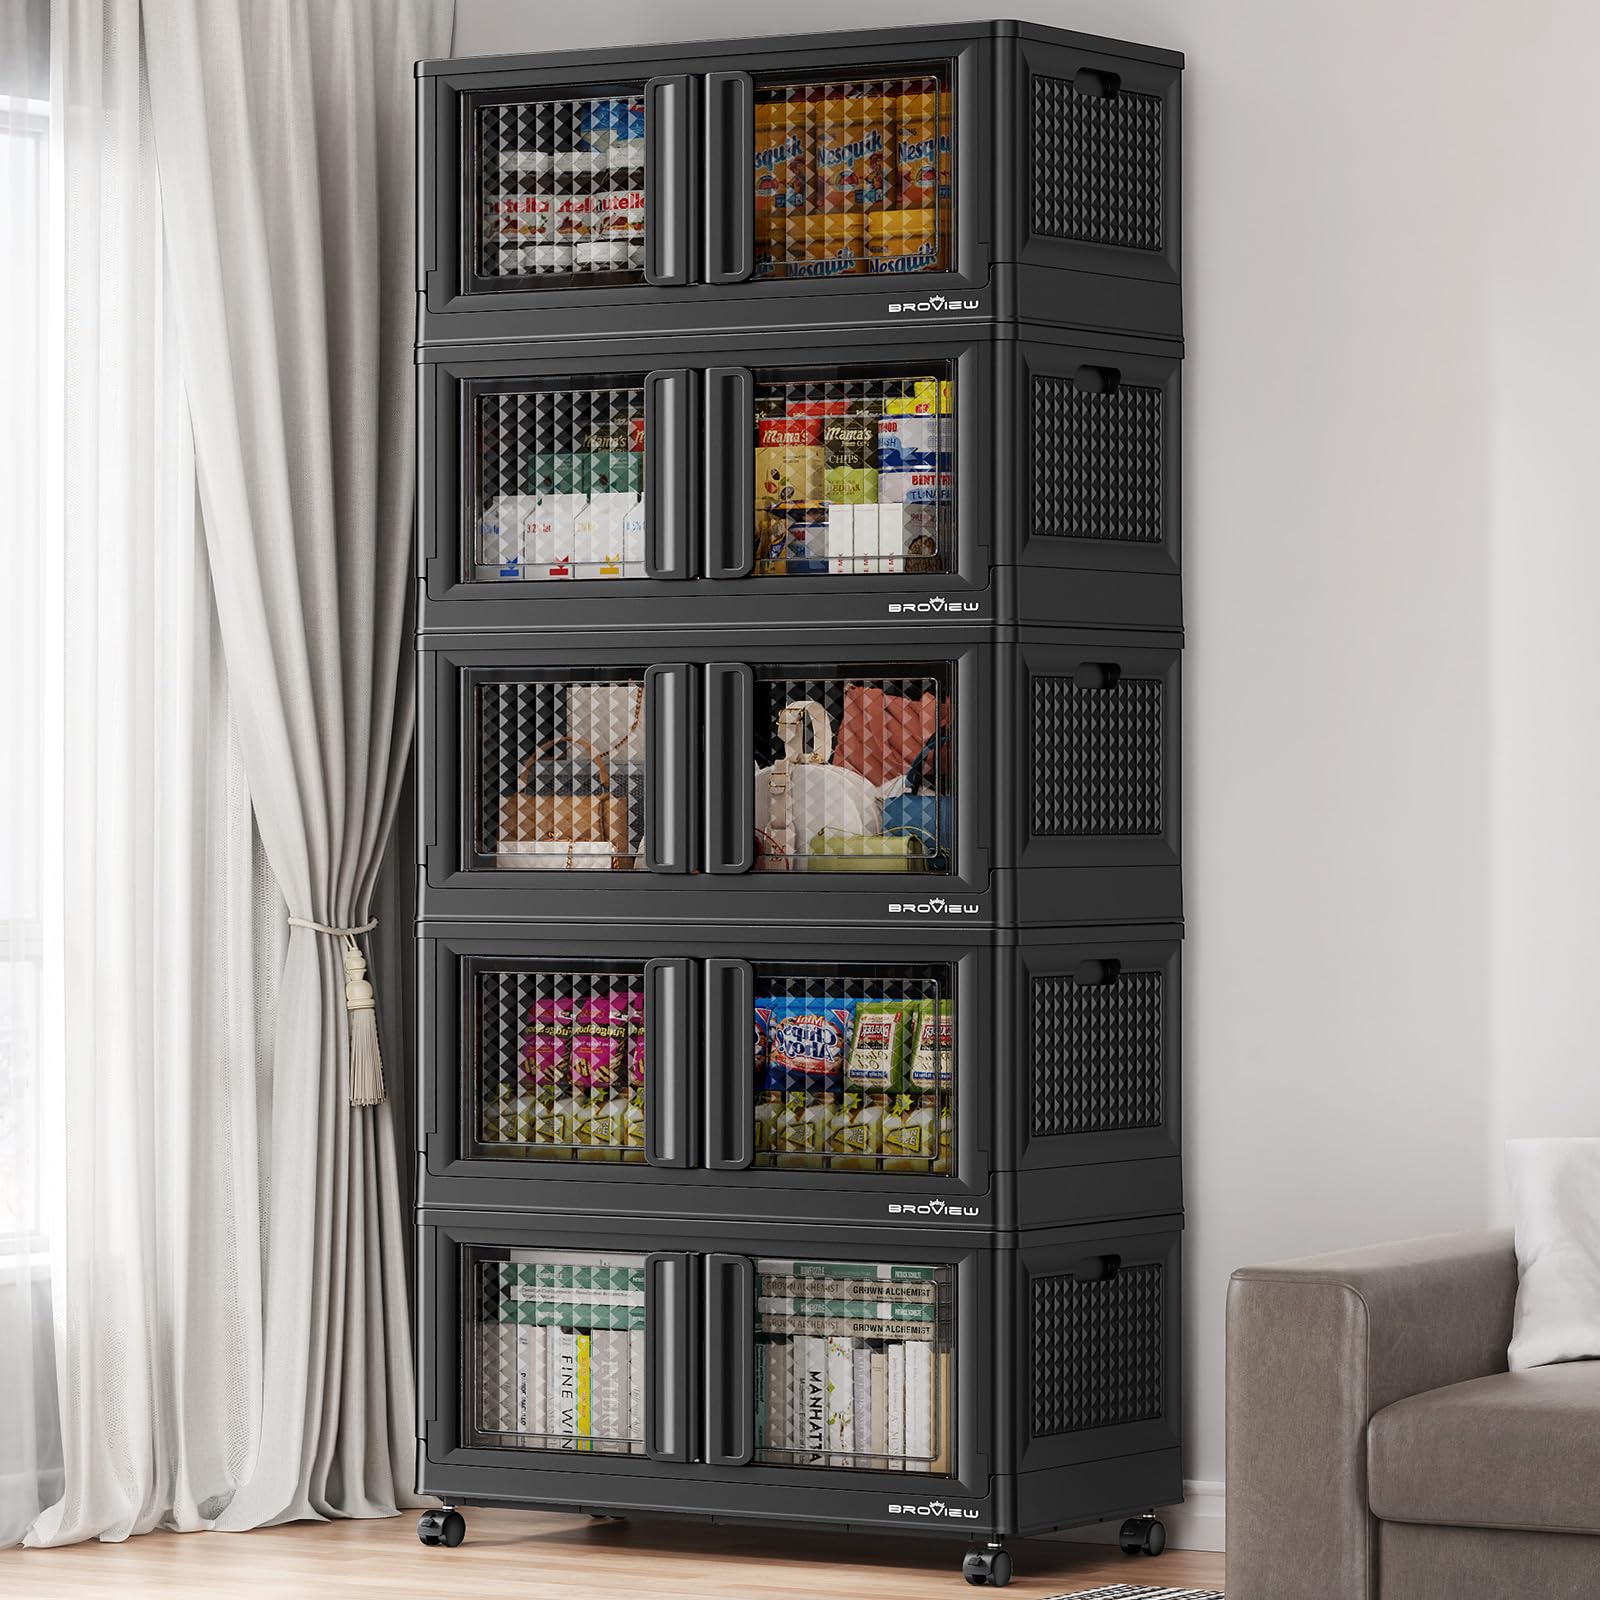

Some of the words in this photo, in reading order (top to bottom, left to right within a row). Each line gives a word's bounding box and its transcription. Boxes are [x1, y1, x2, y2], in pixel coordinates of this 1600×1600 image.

[755, 134, 803, 170] squik
[816, 130, 883, 170] Nesquik
[888, 295, 979, 313] BROVIEW
[762, 430, 809, 443] Mama's
[824, 427, 872, 441] Mama's
[828, 455, 859, 464] CHIPS
[888, 597, 979, 612] BROVIEW
[888, 898, 979, 913] BROVIEW
[888, 1199, 979, 1216] BROVIEW
[852, 1286, 884, 1296] GROWN
[885, 1288, 932, 1298] ALCHEMIST
[852, 1323, 884, 1333] GROWN
[885, 1325, 931, 1336] ALCHEMIST
[562, 1355, 574, 1399] FINE
[809, 1371, 823, 1463] MANHATTA
[562, 1408, 574, 1450] WIN
[888, 1501, 979, 1518] BROVIEW
